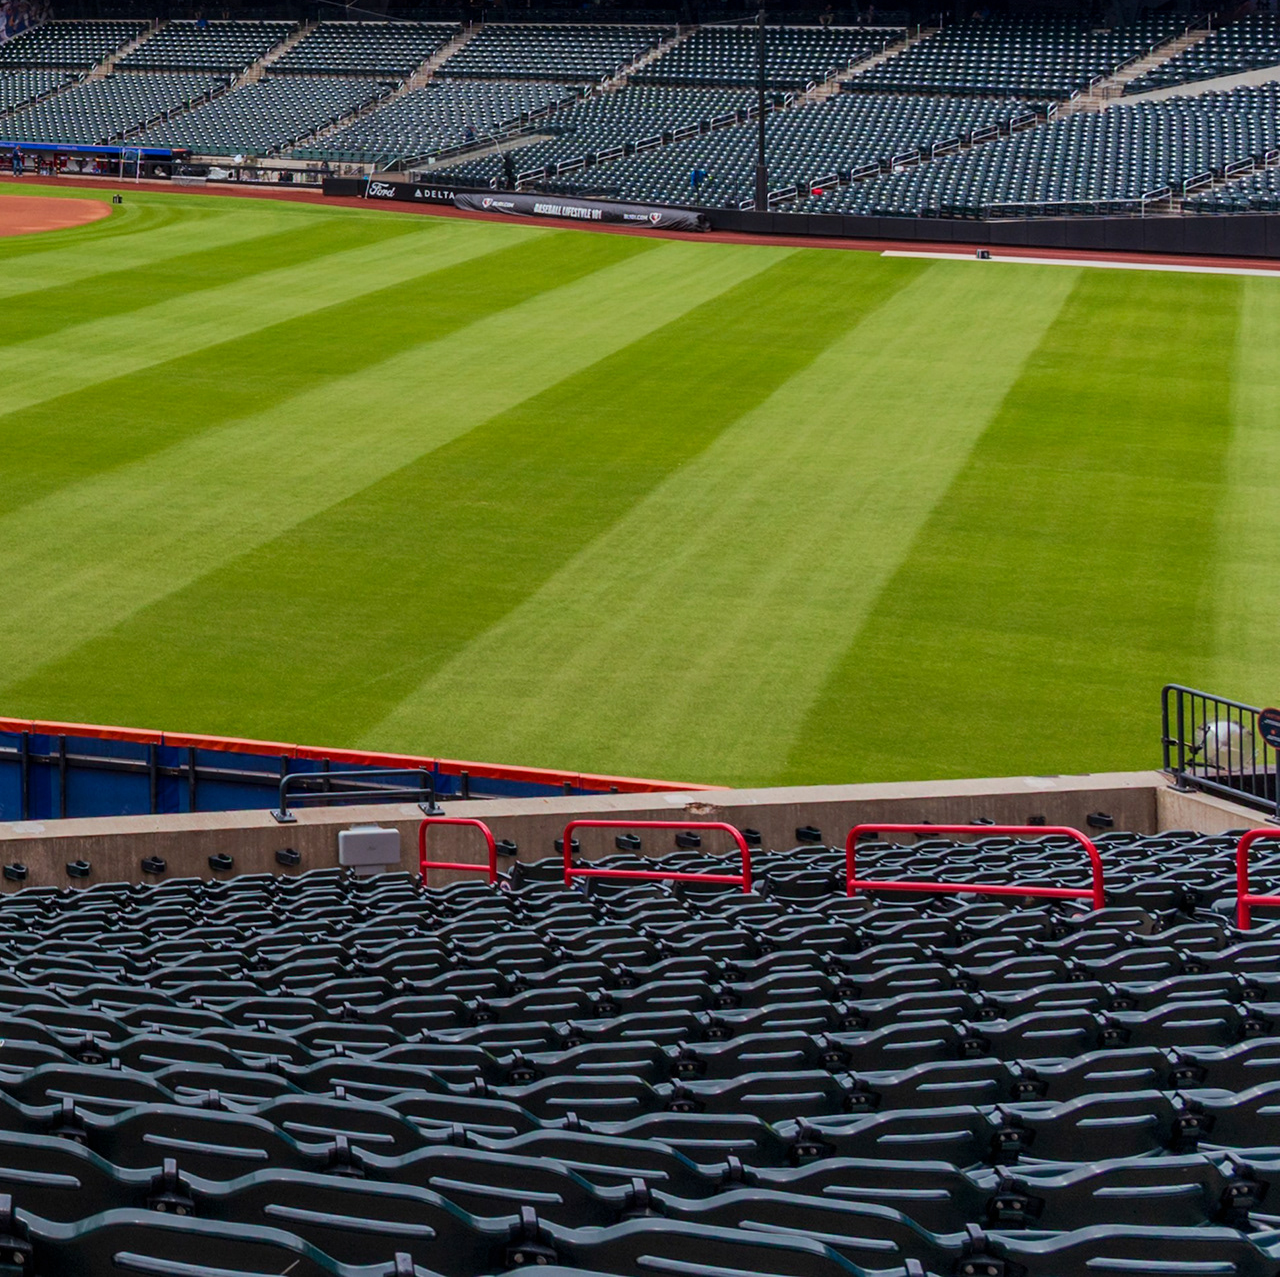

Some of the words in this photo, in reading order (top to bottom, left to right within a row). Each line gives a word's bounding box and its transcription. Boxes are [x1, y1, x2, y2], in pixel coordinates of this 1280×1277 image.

[369, 182, 395, 198] Ford
[424, 189, 455, 200] DELTA
[534, 203, 562, 215] BASEBALL
[562, 206, 591, 219] LIFESTYLE
[592, 209, 602, 220] 101
